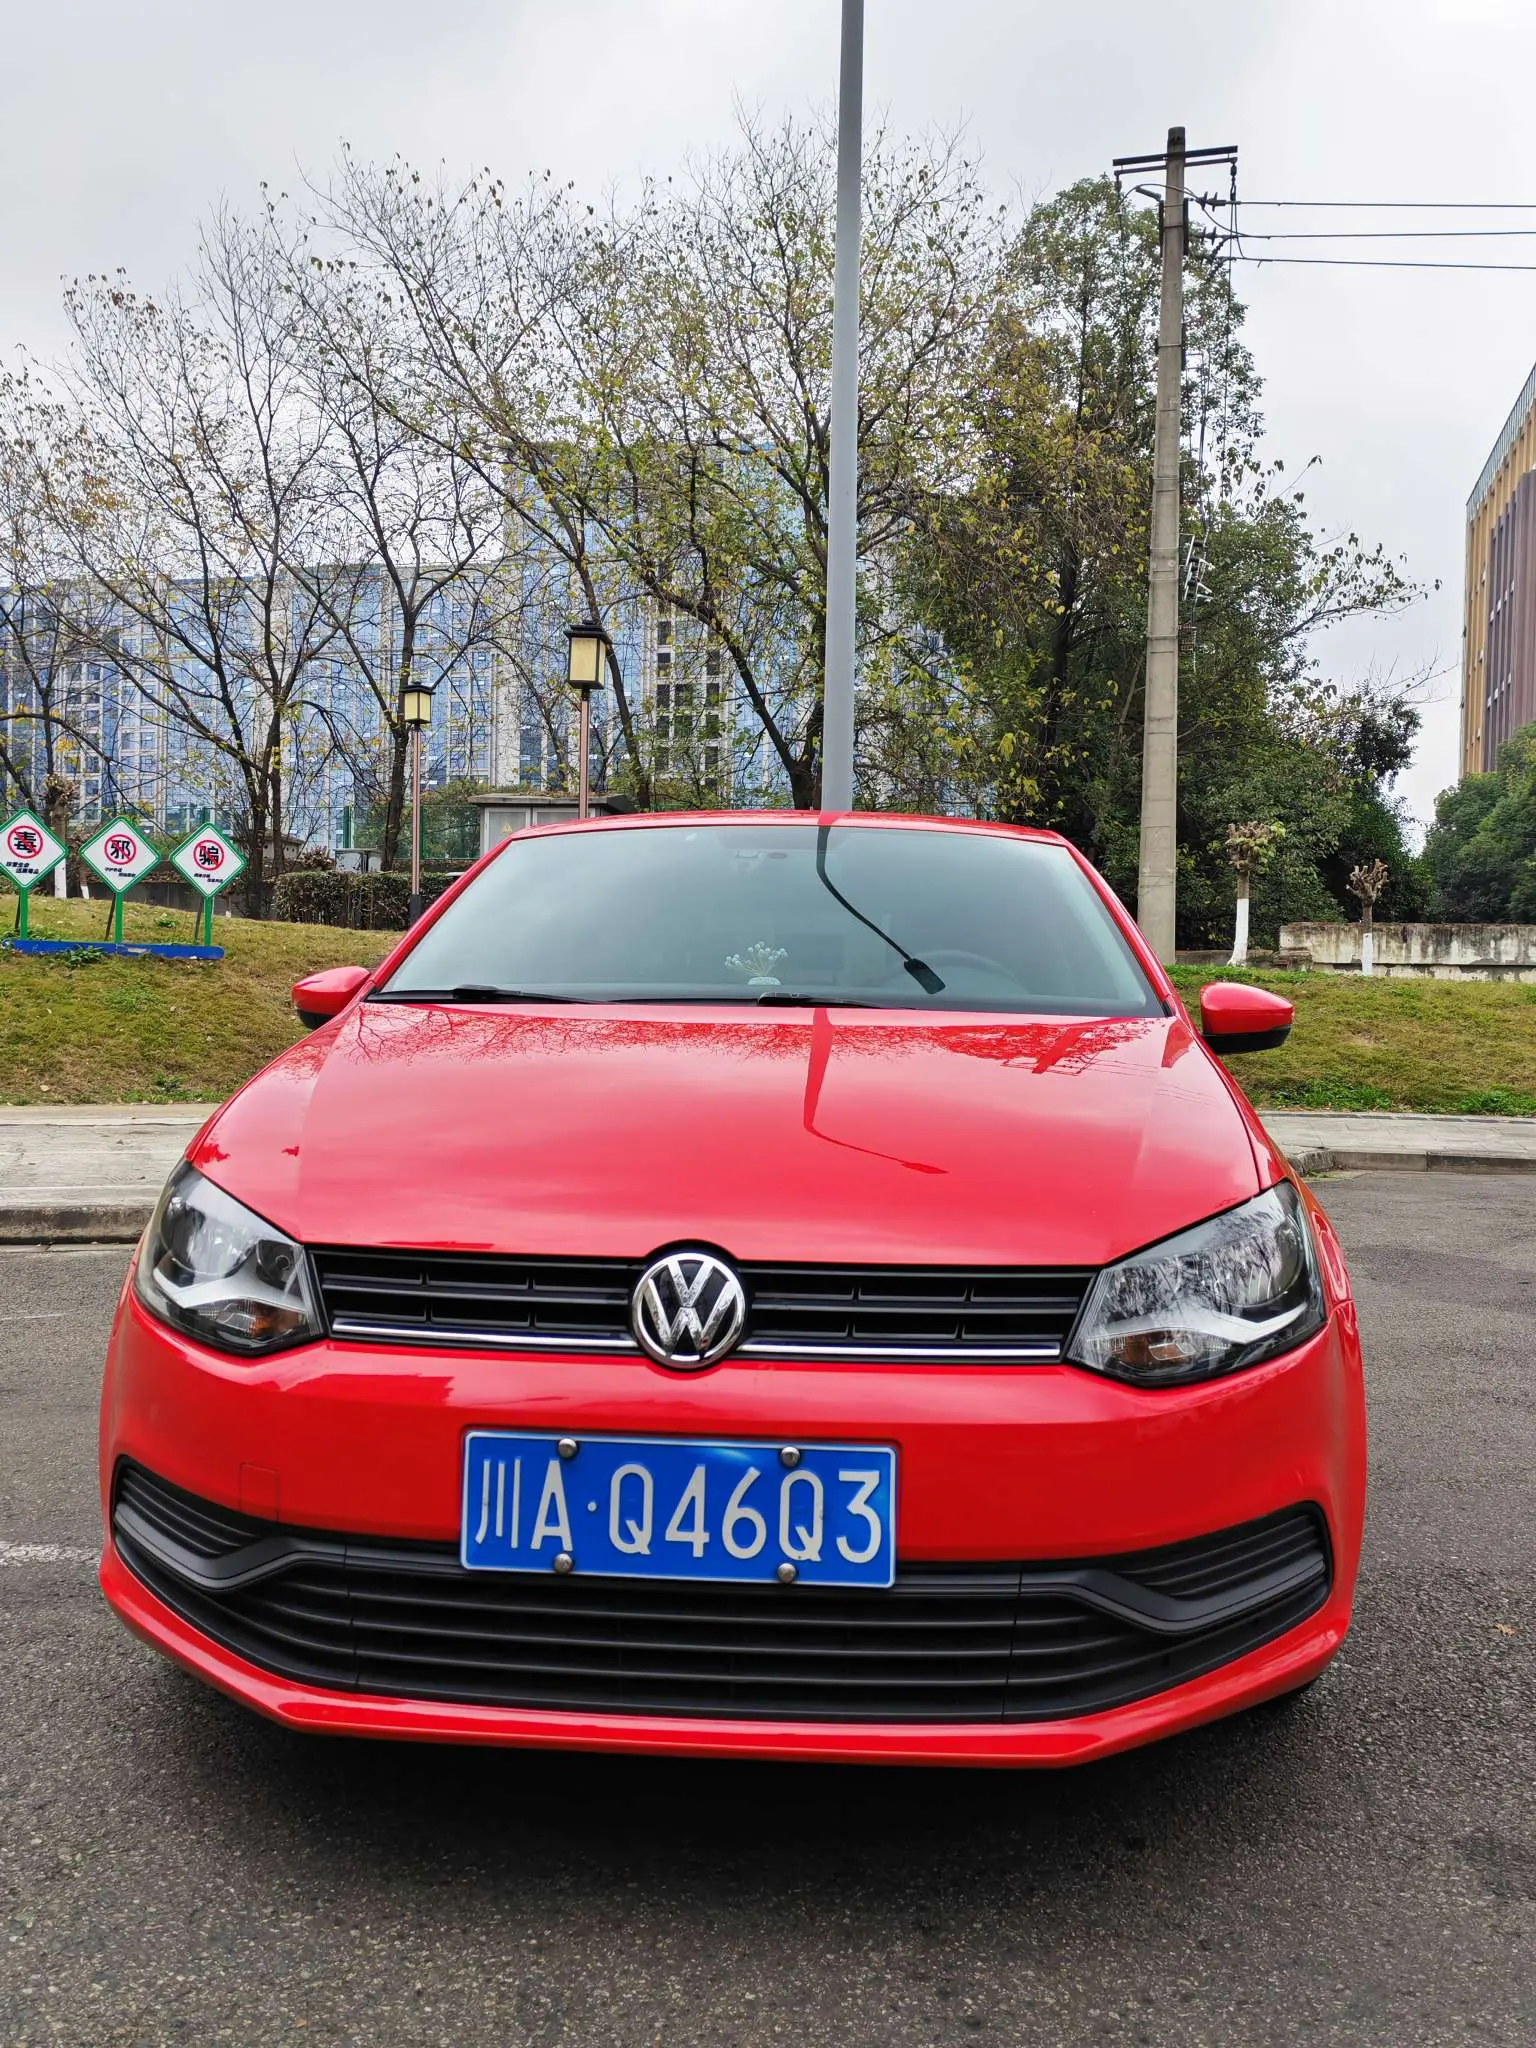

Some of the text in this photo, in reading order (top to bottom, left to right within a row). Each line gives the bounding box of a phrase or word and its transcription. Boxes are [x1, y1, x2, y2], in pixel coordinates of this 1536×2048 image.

[13, 831, 37, 853] 毒
[110, 839, 131, 859] 邪
[198, 845, 220, 865] 骗
